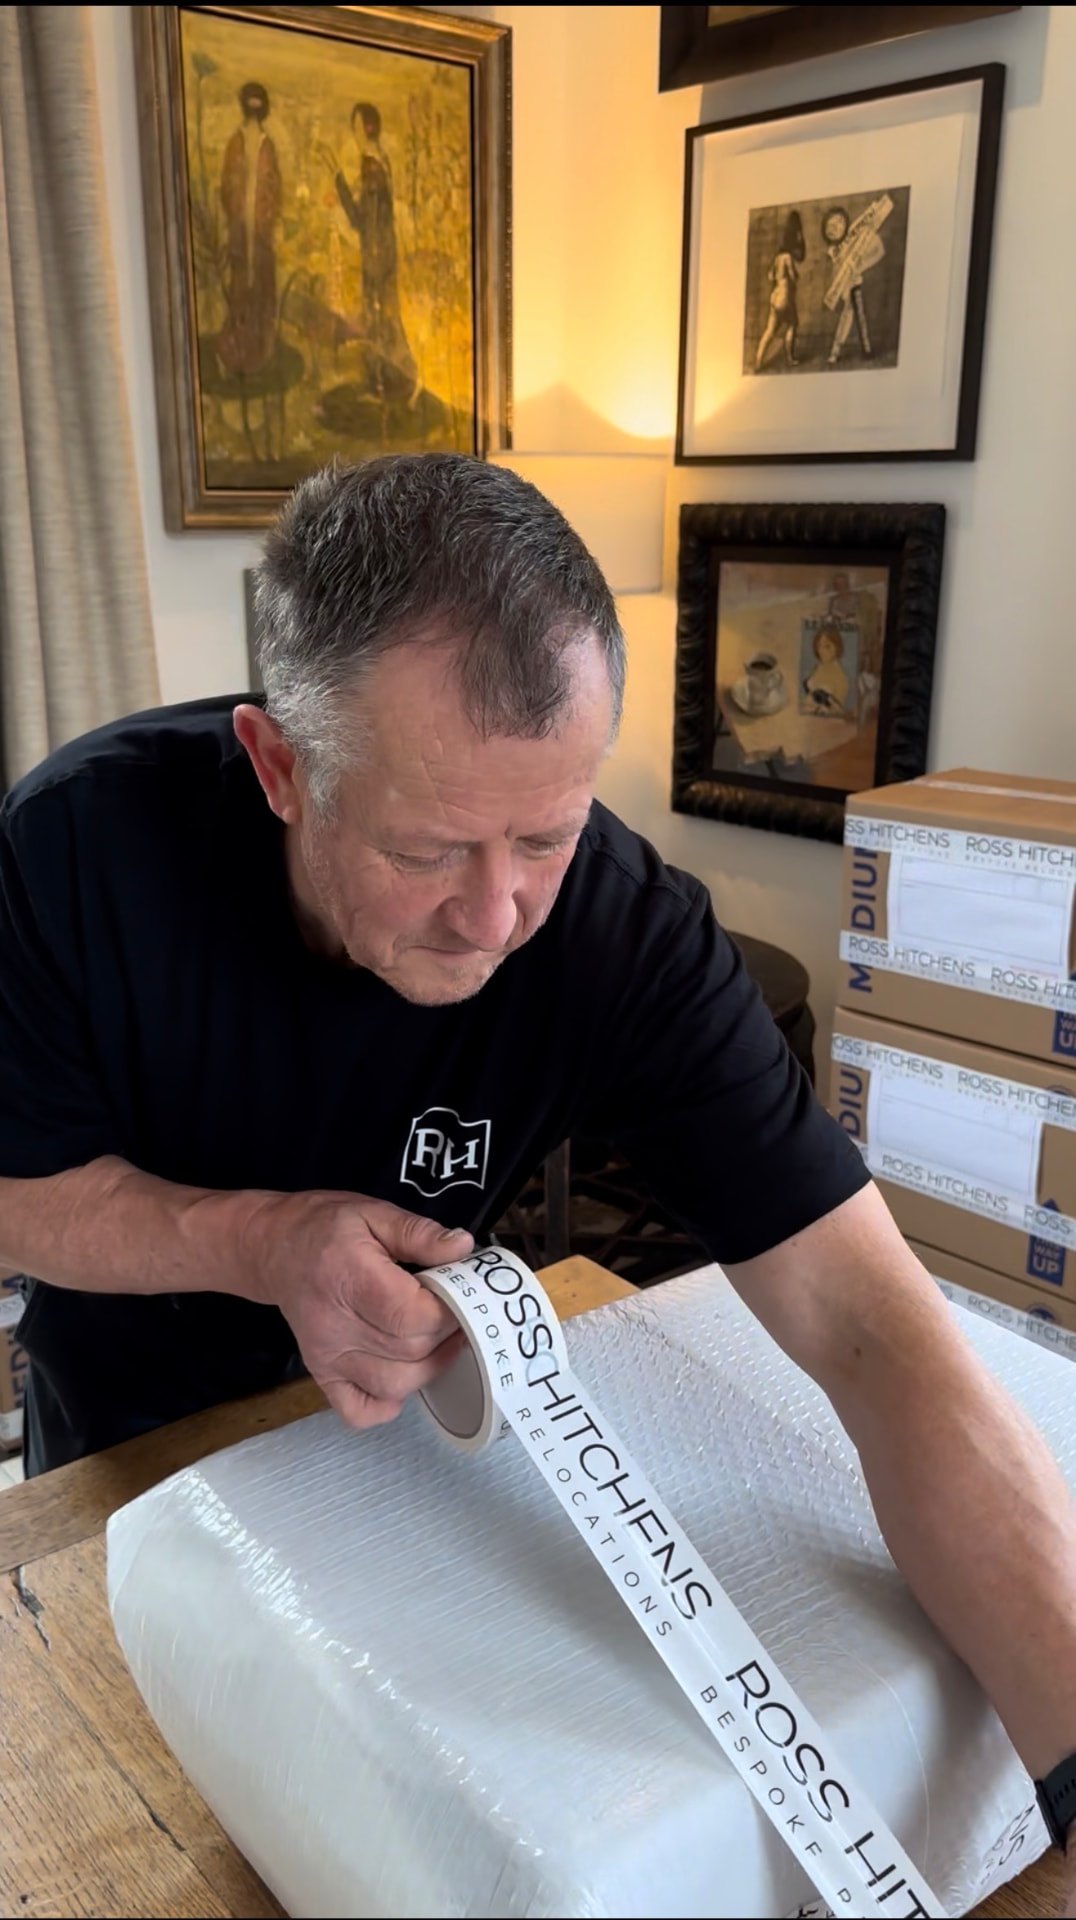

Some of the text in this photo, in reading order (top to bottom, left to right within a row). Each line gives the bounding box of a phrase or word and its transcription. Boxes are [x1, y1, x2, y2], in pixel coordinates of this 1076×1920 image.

[869, 822, 950, 849] HITCHENS
[966, 835, 1013, 858] ROSS
[1018, 844, 1076, 868] HITCH
[848, 935, 889, 958] ROSS
[894, 946, 976, 978] HITCHENS
[990, 966, 1039, 993] ROSS
[833, 1035, 862, 1057] OSS
[865, 1044, 943, 1080] HITCHENS
[957, 1070, 1002, 1097] ROSS
[1008, 1085, 1076, 1118] HITCHE
[411, 1128, 480, 1180] RH
[881, 1153, 923, 1180] ROSS
[927, 1170, 1009, 1212] HITCHENS
[1023, 1203, 1071, 1235] ROSS
[1033, 1254, 1060, 1274] UP
[437, 1266, 514, 1388] BESPOKE
[516, 1407, 673, 1637] RELOCATIONS
[461, 1250, 553, 1360] ROSS
[527, 1370, 713, 1620] HITCHENS
[725, 1660, 850, 1823] ROSS
